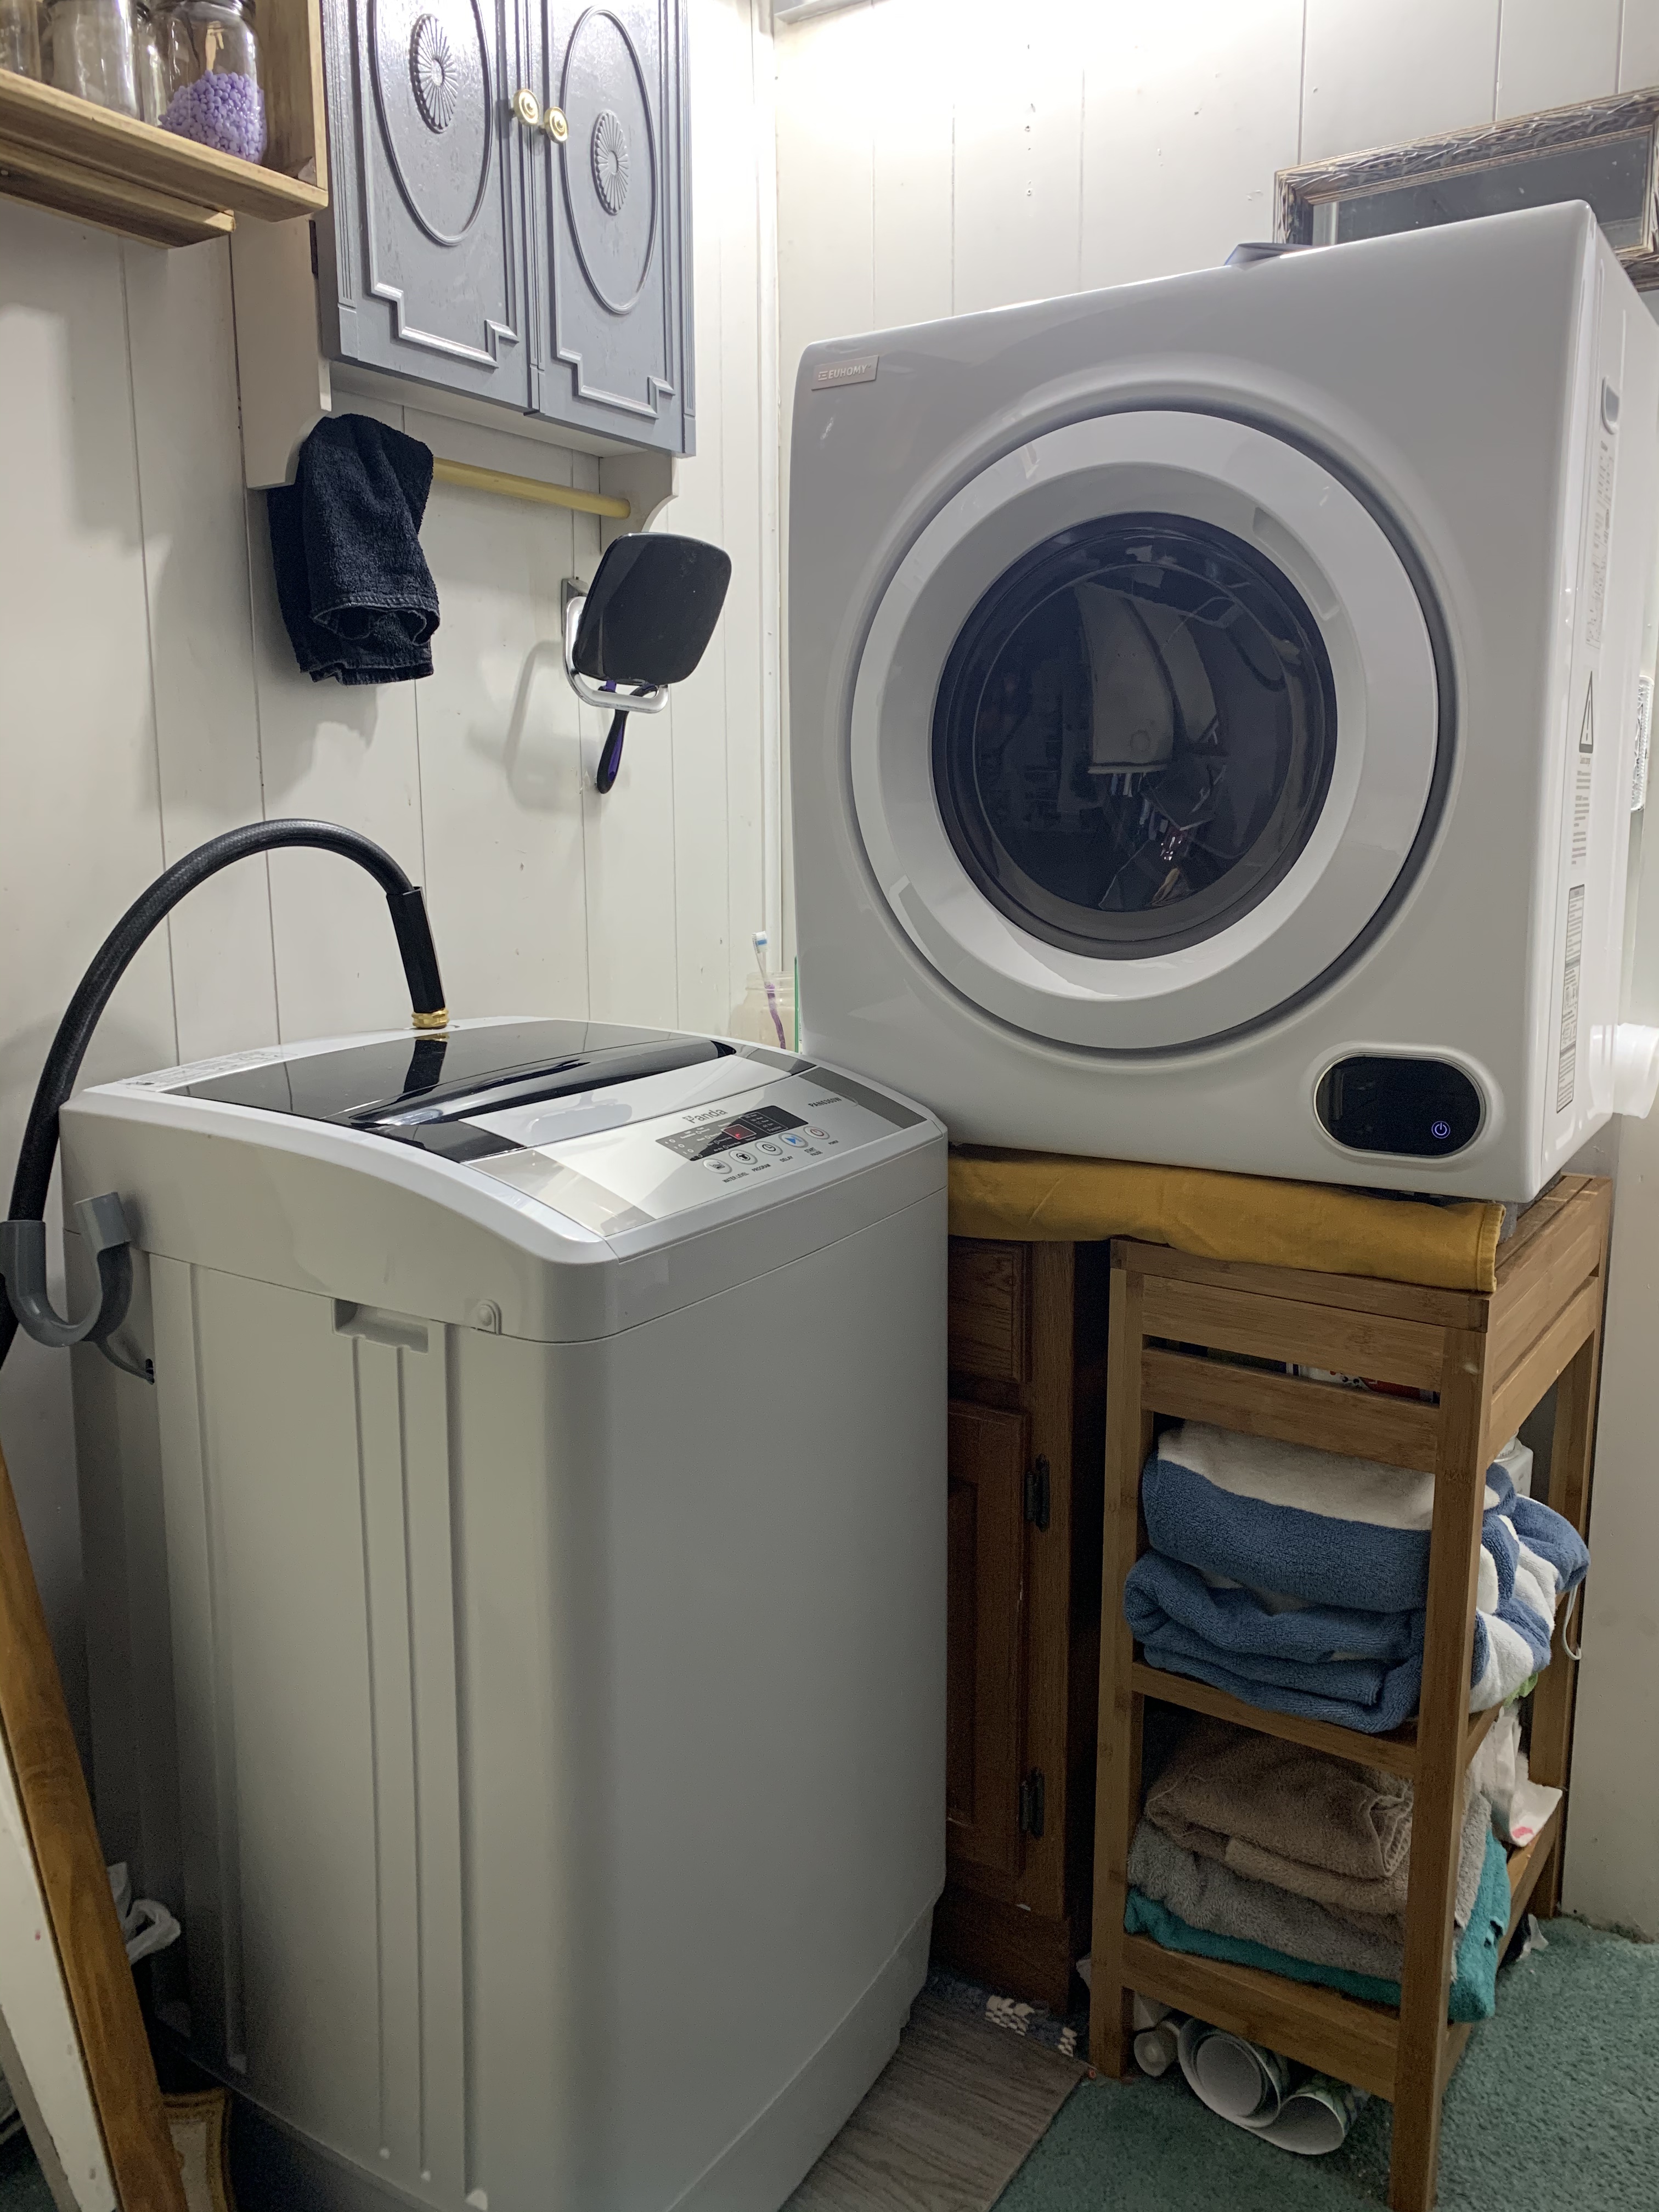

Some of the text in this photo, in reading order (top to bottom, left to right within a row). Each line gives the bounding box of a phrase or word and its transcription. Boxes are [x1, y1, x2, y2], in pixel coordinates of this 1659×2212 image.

[828, 364, 867, 379] EUHOMY
[682, 1109, 728, 1124] Panda
[751, 1164, 771, 1172] PROGRAM
